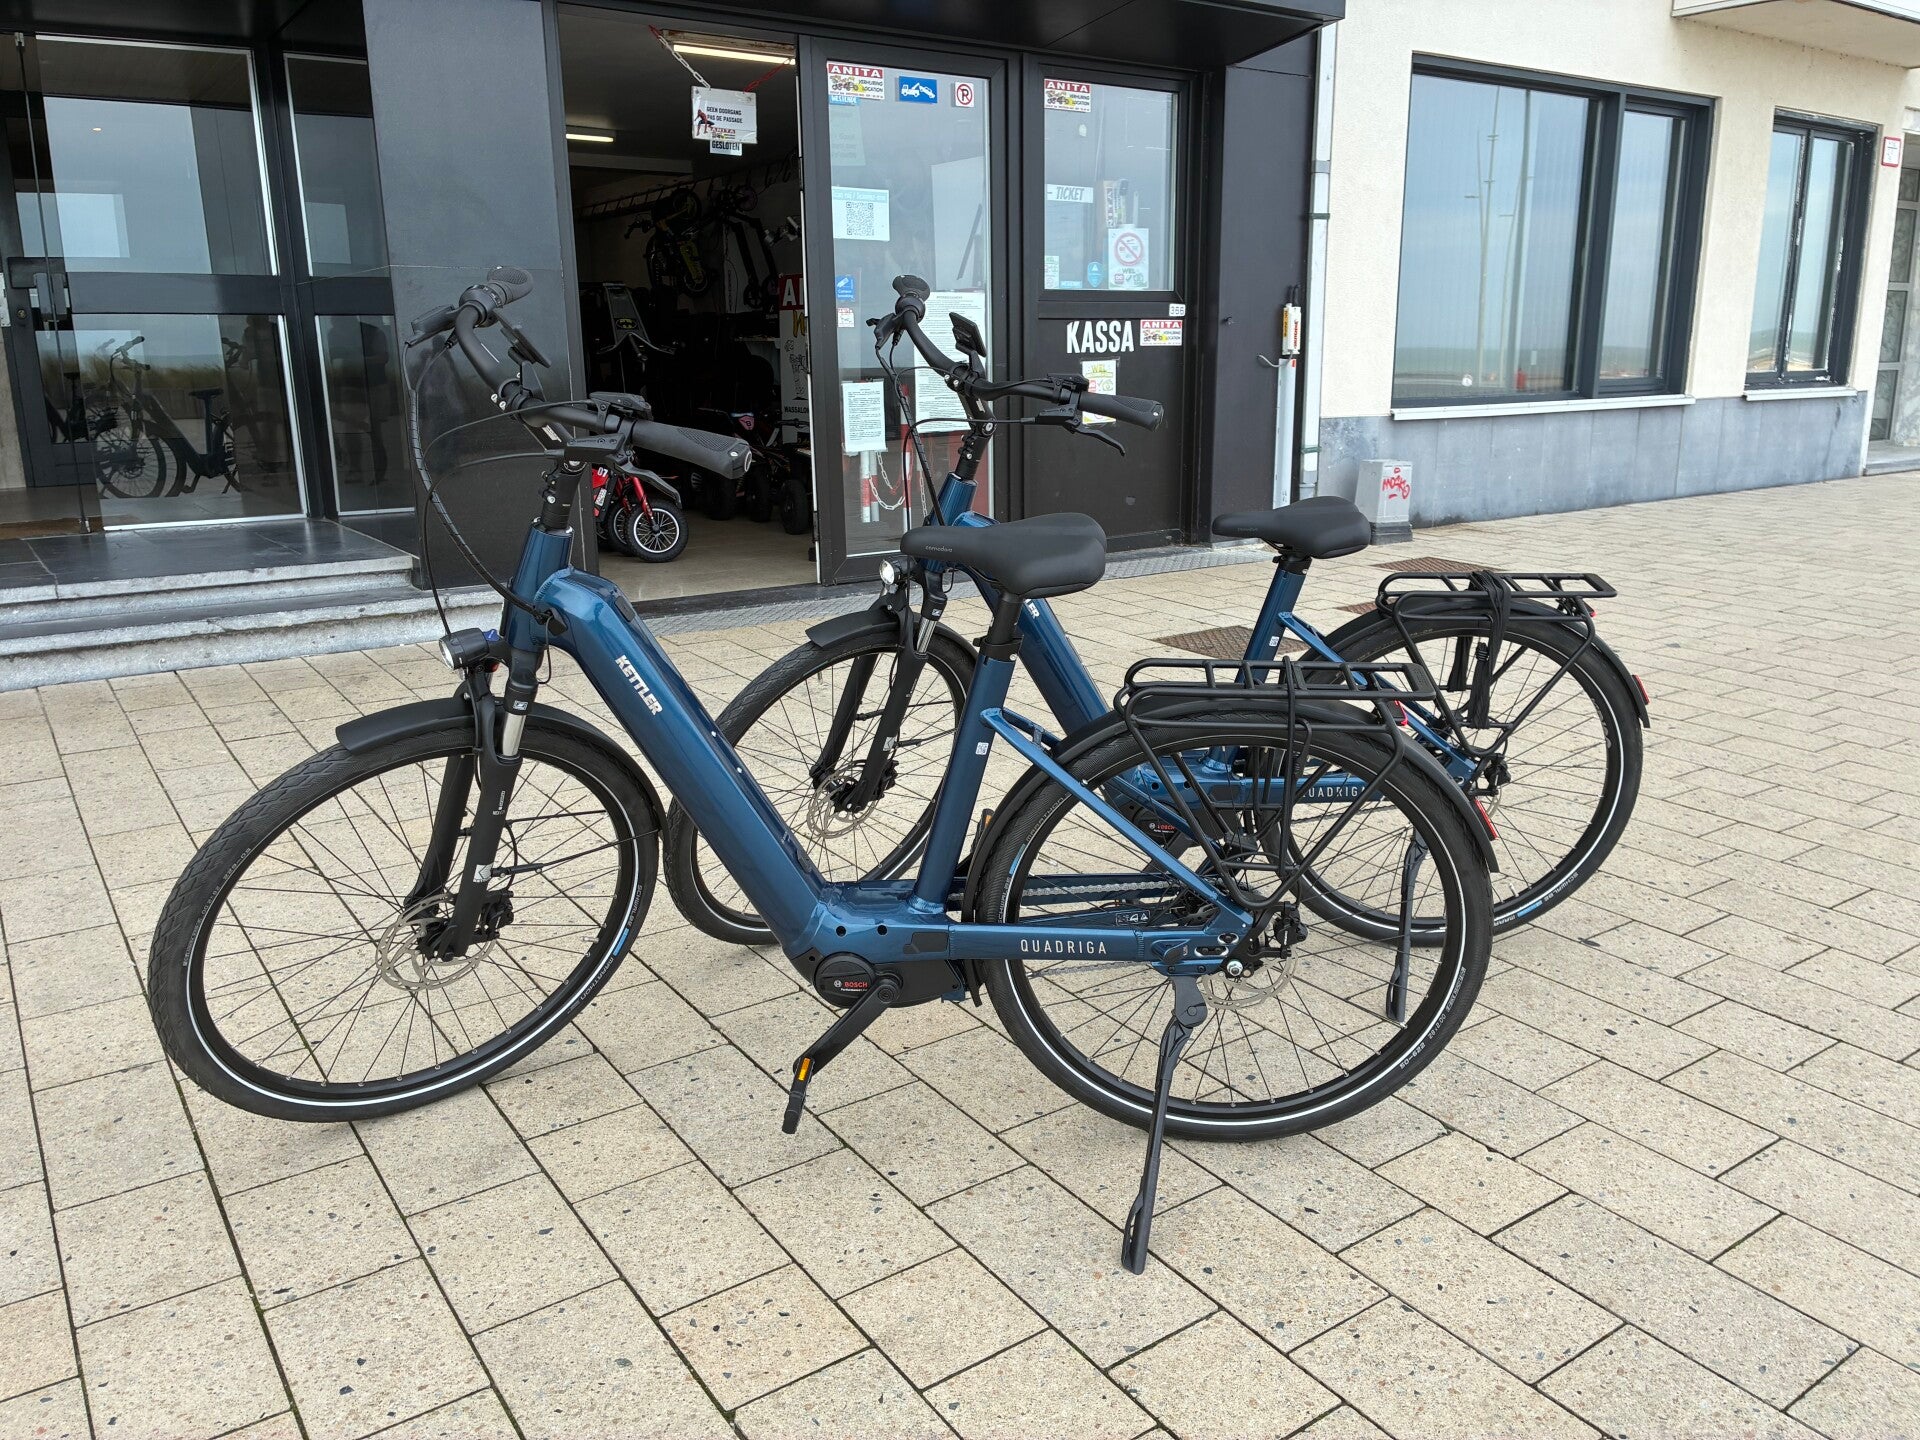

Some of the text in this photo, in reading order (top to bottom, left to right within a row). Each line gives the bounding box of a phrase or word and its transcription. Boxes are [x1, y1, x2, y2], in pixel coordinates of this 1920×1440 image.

[830, 65, 881, 78] ANITA
[1046, 81, 1089, 93] ANITA
[711, 140, 740, 151] GESLOTEN
[1056, 186, 1085, 201] TICKET
[1143, 321, 1181, 329] ANITA
[1066, 320, 1134, 354] KASSA
[597, 466, 609, 478] 07
[615, 654, 663, 716] KETTLER
[628, 885, 643, 926] SCHWALBE
[1020, 939, 1107, 955] QUADRIGA
